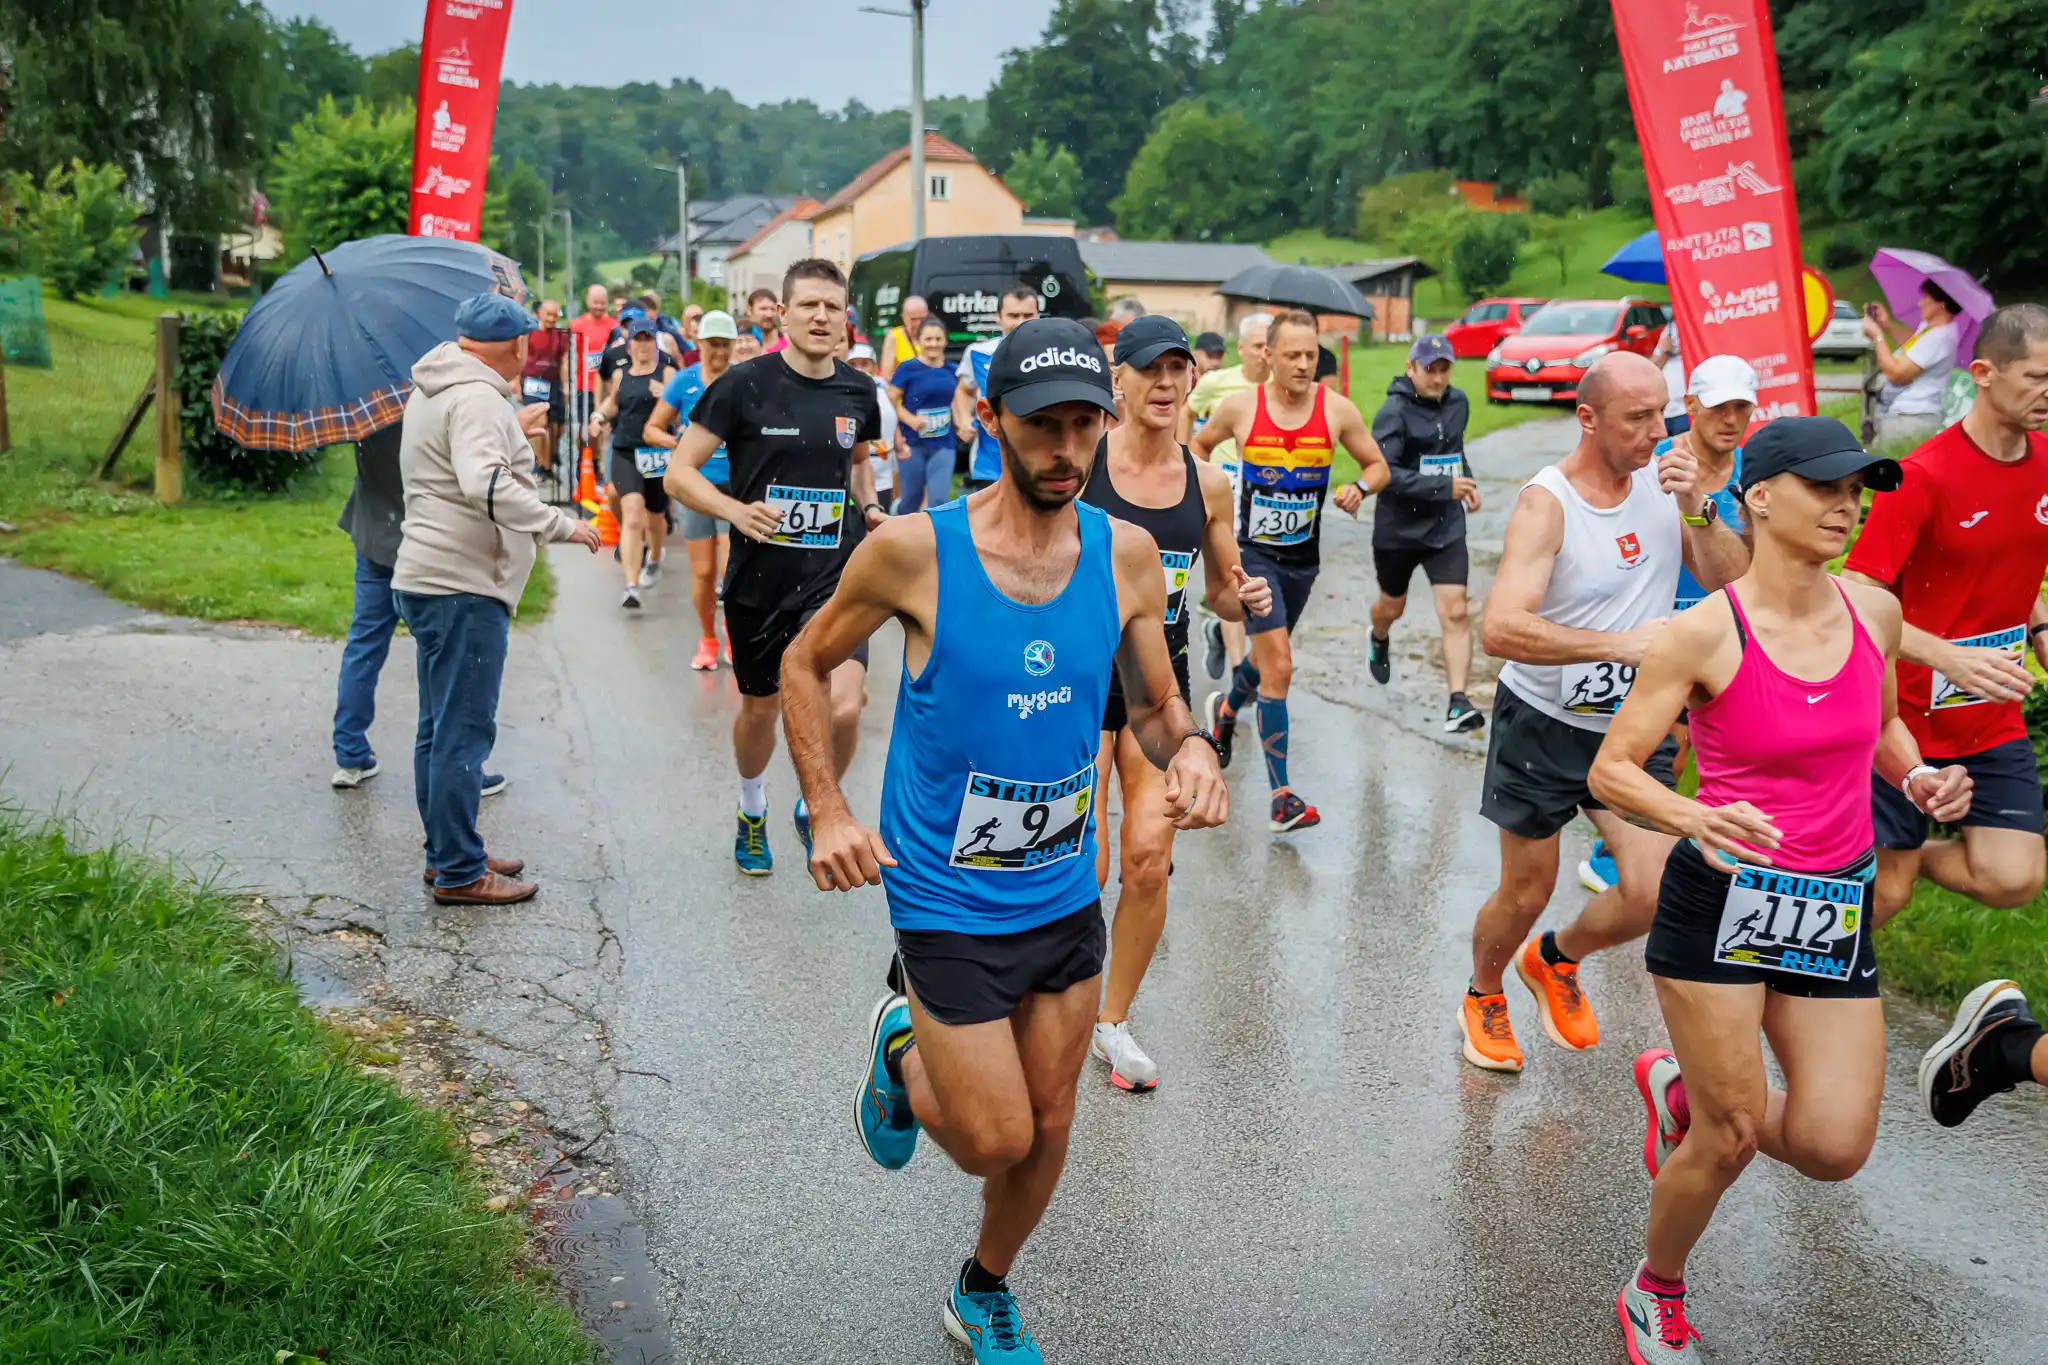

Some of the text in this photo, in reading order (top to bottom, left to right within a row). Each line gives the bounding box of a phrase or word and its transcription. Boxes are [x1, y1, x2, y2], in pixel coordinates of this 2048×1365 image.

[1020, 347, 1101, 373] adidas
[769, 487, 843, 502] STRIDON
[789, 502, 821, 530] 61
[1269, 511, 1298, 532] 30
[801, 533, 836, 545] RUN
[1593, 662, 1637, 698] 39
[972, 768, 1091, 803] STRIDON
[1023, 804, 1050, 848] 9
[1023, 838, 1076, 867] RUN
[1737, 868, 1862, 905] STRIDON
[1755, 895, 1838, 950] 112
[1780, 950, 1845, 976] RUN
